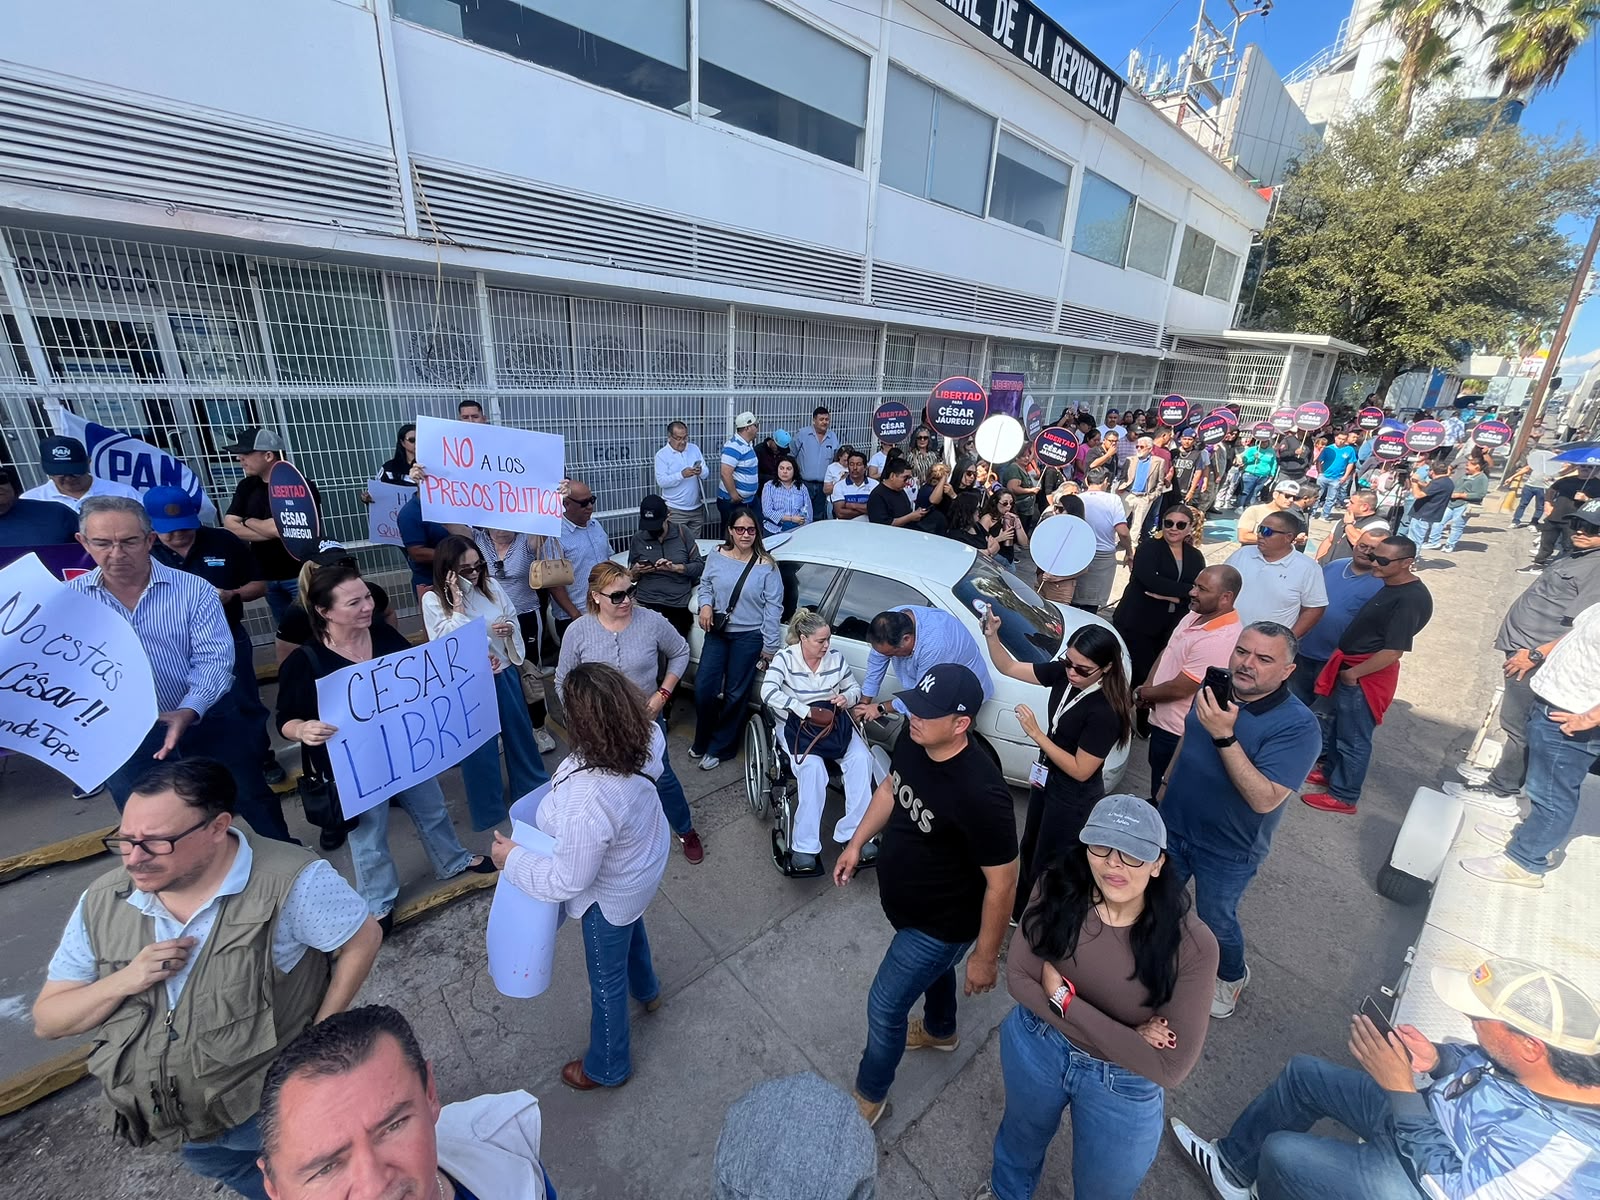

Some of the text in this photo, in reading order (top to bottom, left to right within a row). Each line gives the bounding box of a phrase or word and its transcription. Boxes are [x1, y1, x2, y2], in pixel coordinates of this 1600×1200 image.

[992, 0, 1018, 49] DE
[1023, 13, 1045, 70] LA
[1050, 35, 1118, 121] REPUBLICA
[81, 257, 158, 294] PÚBLICA
[935, 390, 982, 401] LIBERTAD
[876, 410, 908, 418] LIBERTAD
[935, 416, 975, 426] JÁUREGUI
[938, 405, 974, 418] CÉSAR
[880, 421, 905, 430] CÉSAR
[1042, 443, 1068, 457] CÉSAR
[1043, 432, 1076, 449] LIBERTAD
[442, 436, 526, 474] NO A LOS
[108, 449, 182, 491] PAN
[271, 485, 306, 498] LIBERTAD
[421, 474, 495, 512] PRESOS
[280, 508, 308, 526] CÉSAR
[282, 526, 313, 539] JÁUREGUI
[0, 591, 123, 692] No estás
[347, 637, 468, 723] CÉSAR
[919, 673, 936, 694] NY
[341, 674, 482, 799] LIBRE
[891, 770, 935, 833] BOSS
